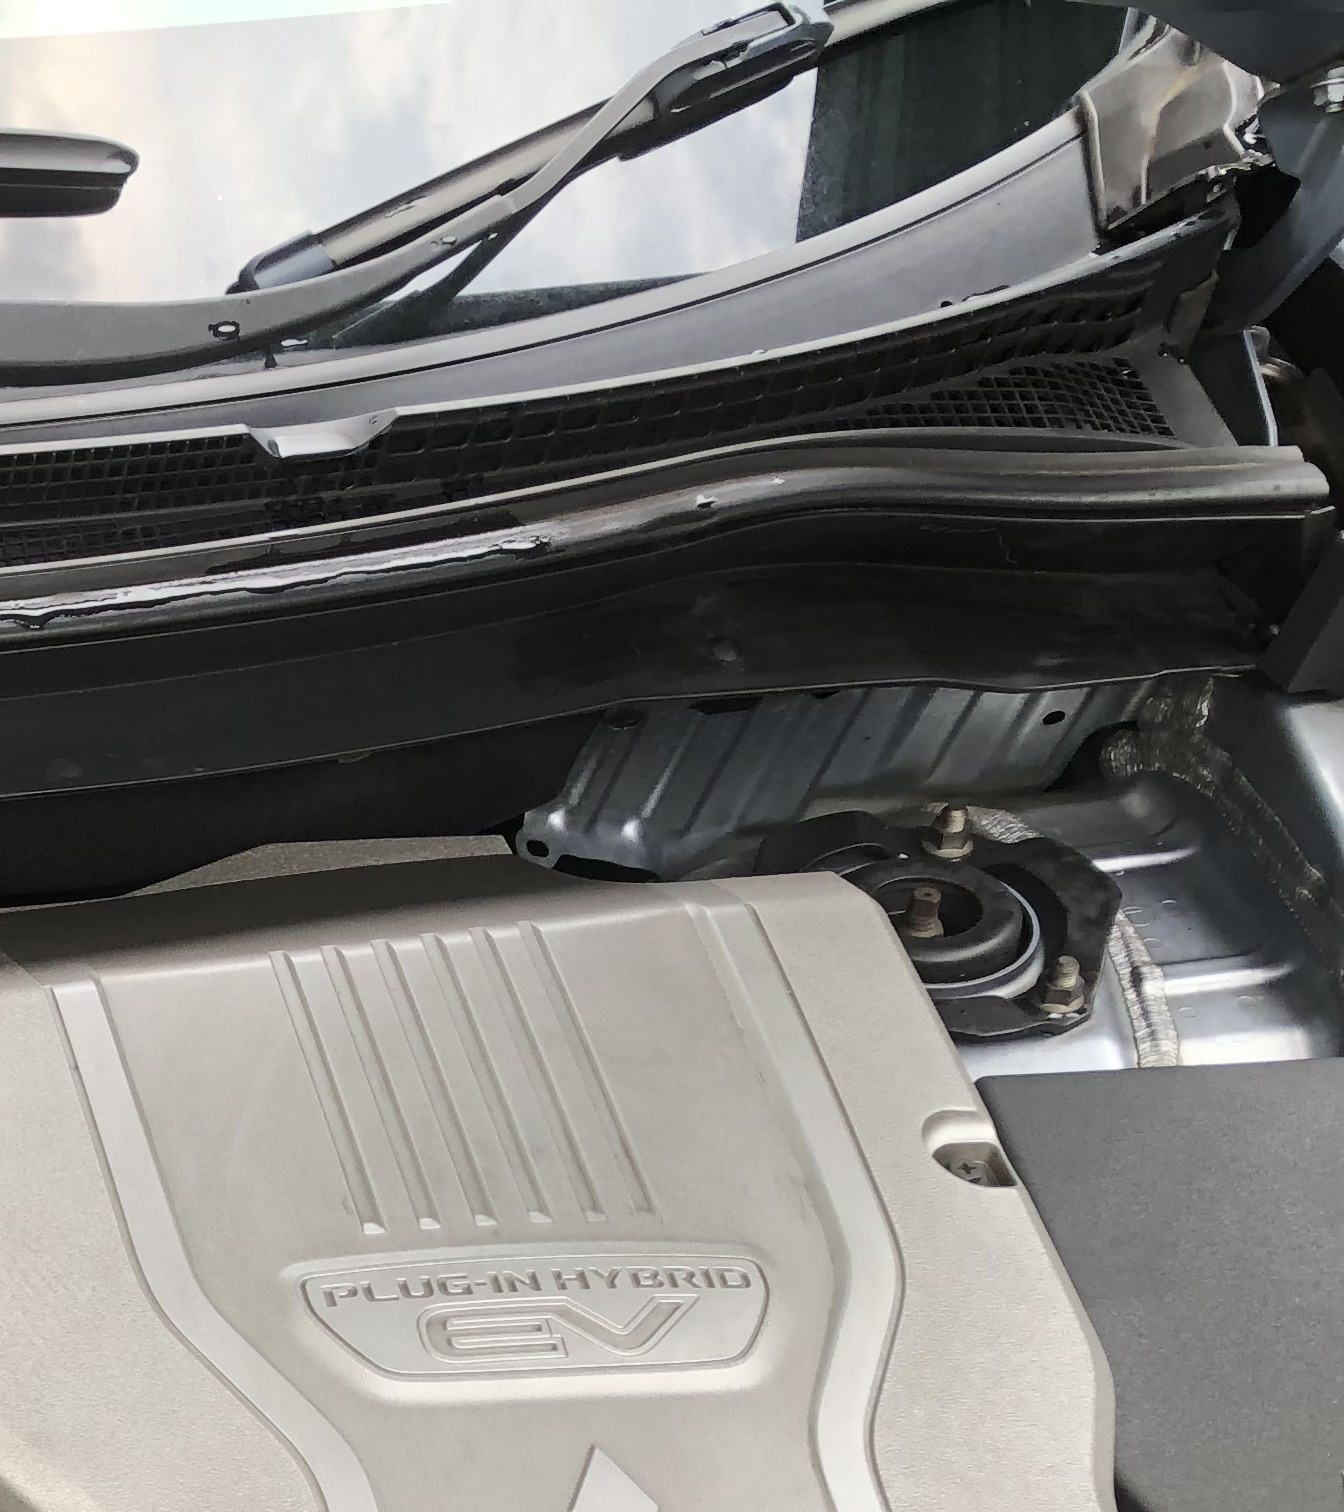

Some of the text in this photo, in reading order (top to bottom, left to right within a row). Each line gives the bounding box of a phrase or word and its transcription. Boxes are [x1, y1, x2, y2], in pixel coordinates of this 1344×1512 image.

[320, 1264, 752, 1308] PLUG-IN HYBRID
[416, 1293, 701, 1364] EV
